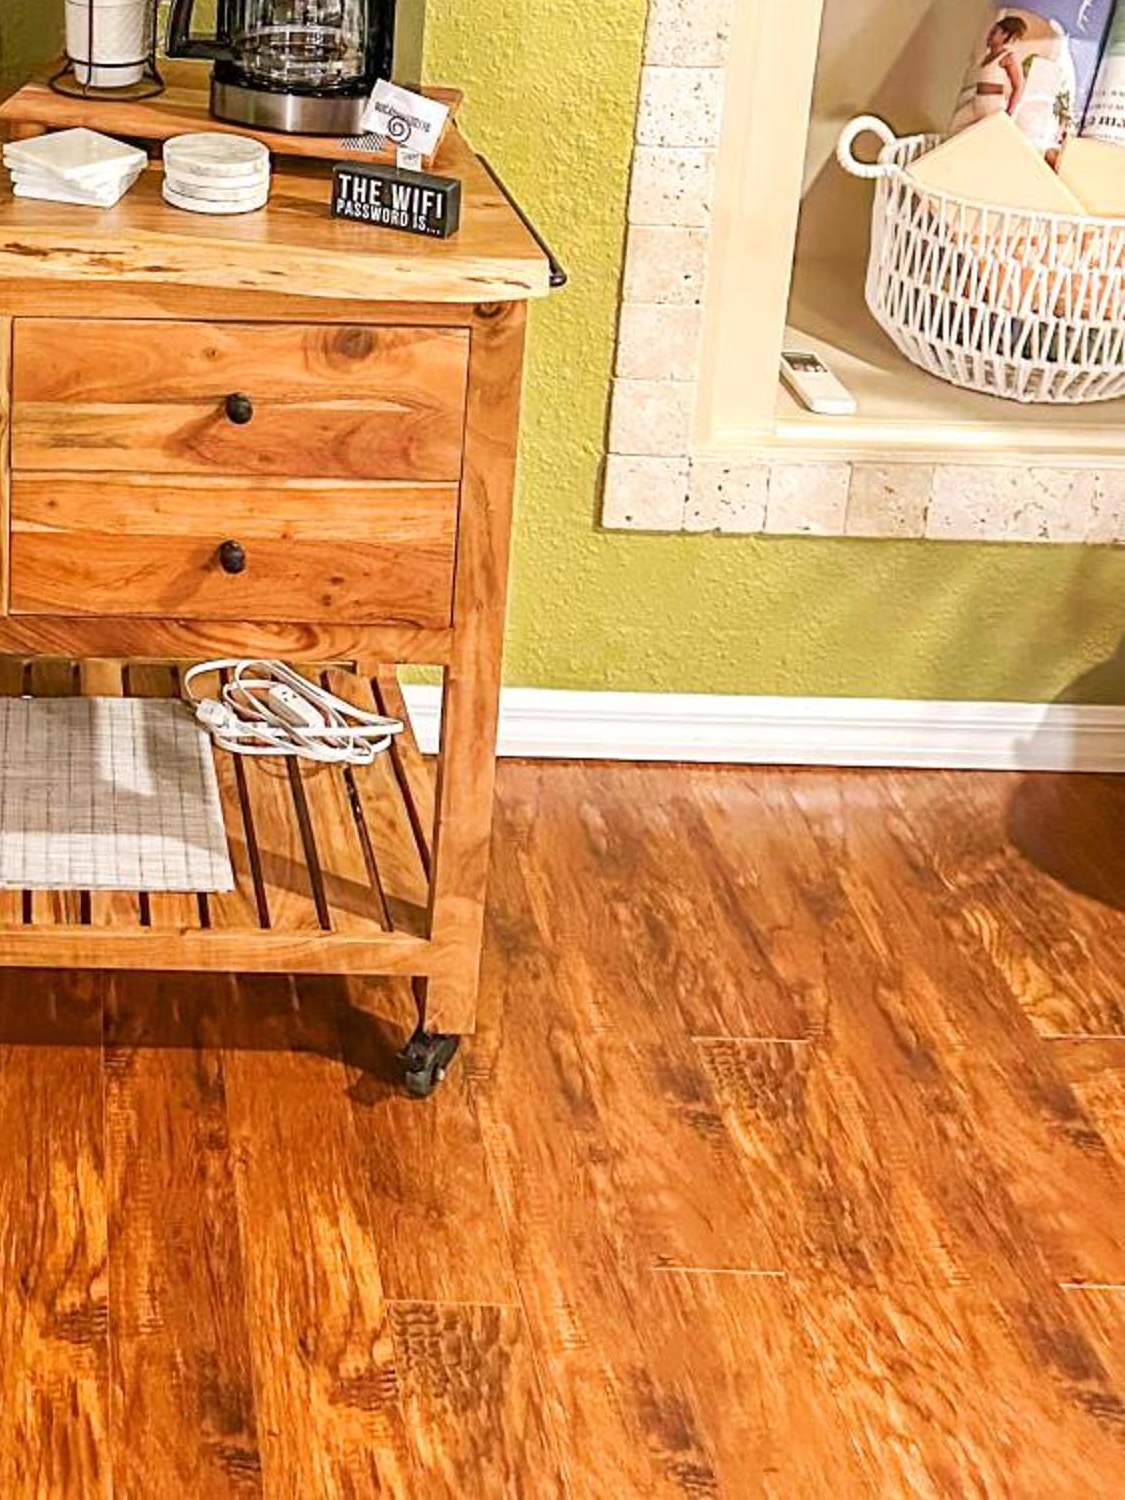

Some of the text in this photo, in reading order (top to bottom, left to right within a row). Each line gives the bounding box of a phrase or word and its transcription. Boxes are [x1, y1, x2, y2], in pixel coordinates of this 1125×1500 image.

[335, 198, 409, 228] PASSWORD
[338, 174, 444, 219] THE WIFI
